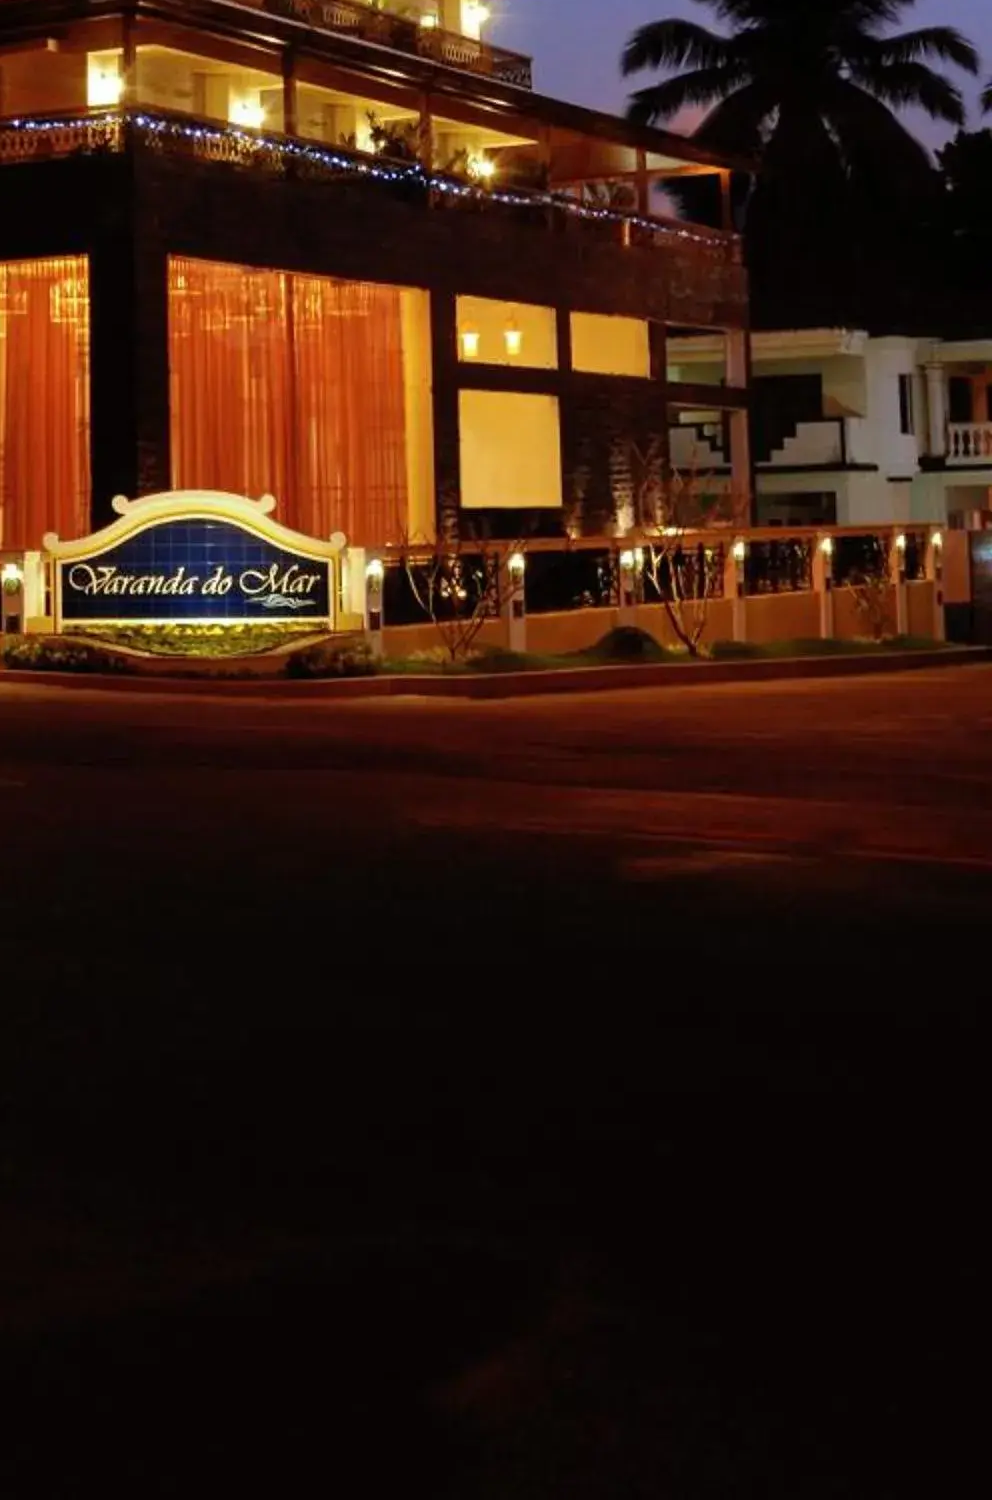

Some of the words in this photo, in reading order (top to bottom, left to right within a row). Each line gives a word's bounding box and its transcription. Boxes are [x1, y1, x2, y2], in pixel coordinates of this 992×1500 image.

[68, 563, 199, 596] Varanda
[201, 565, 232, 596] do
[239, 562, 321, 595] Mar
